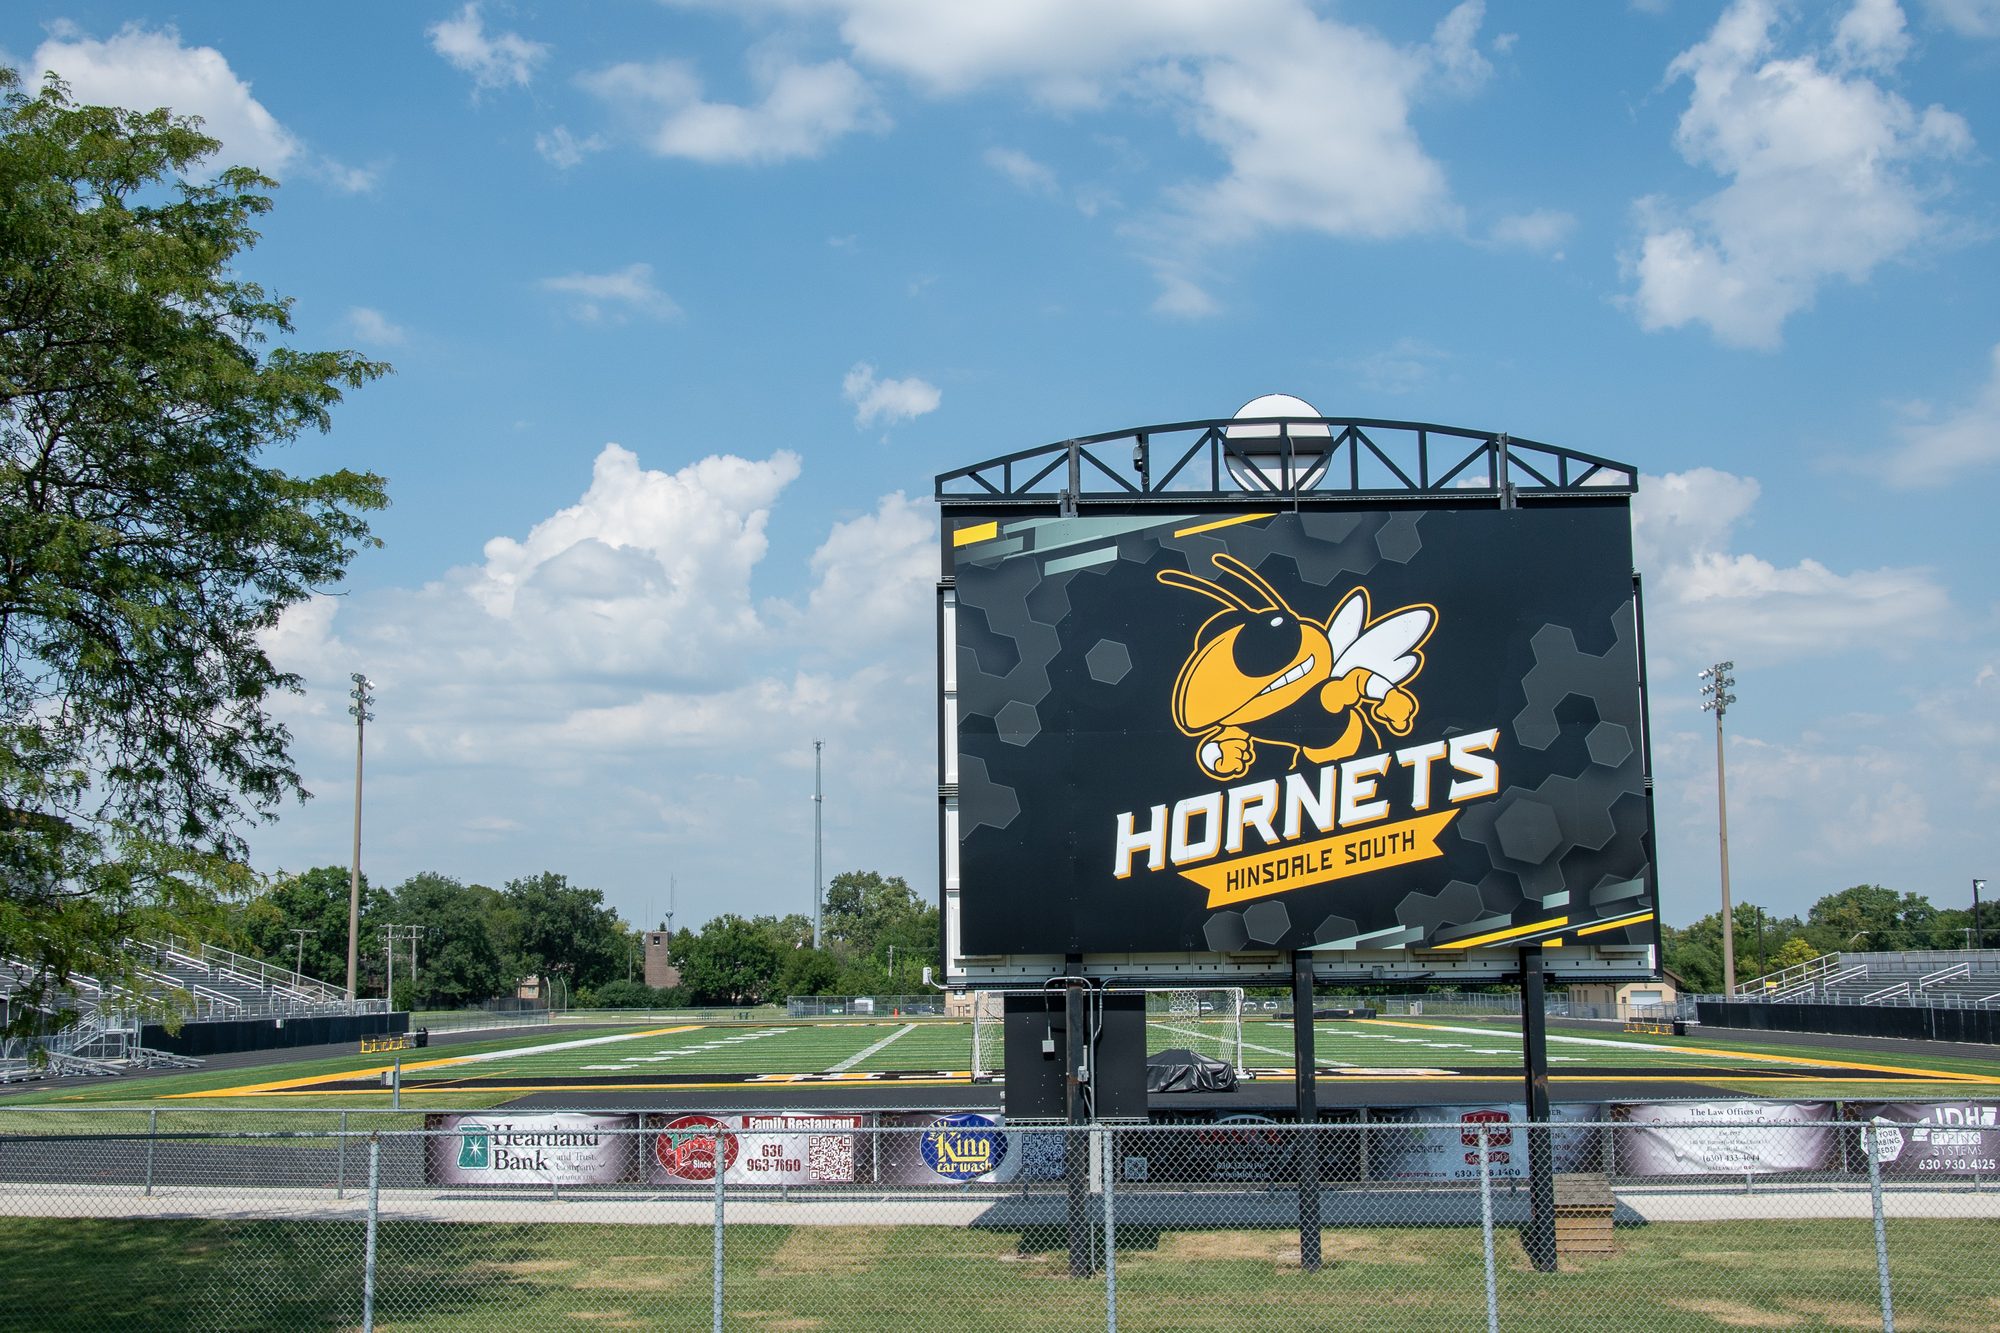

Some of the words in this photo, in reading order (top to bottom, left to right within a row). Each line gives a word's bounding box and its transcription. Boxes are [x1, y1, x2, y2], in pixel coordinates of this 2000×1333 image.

[1113, 728, 1500, 880] HORNETS
[1226, 848, 1333, 893] HINSDALE
[1345, 829, 1416, 865] SOUTH
[1689, 1108, 1706, 1116] The
[1707, 1108, 1724, 1116] Law
[1727, 1107, 1753, 1116] Offices
[1754, 1107, 1763, 1115] of
[749, 1117, 785, 1129] Family
[788, 1117, 855, 1129] Restaurant
[492, 1124, 600, 1147] Heartland
[1879, 1130, 1897, 1138] YOUR
[1933, 1133, 1980, 1144] PIPING
[761, 1145, 784, 1158] 630
[934, 1131, 990, 1163] King
[1933, 1146, 1981, 1156] SYSTEMS
[494, 1149, 549, 1171] Bank
[556, 1152, 571, 1160] and
[574, 1152, 594, 1160] Trust
[693, 1159, 712, 1169] Since
[746, 1158, 801, 1172] 963-7660
[936, 1162, 957, 1173] car
[959, 1159, 992, 1173] wash
[1454, 1169, 1521, 1178] 630.38.1400
